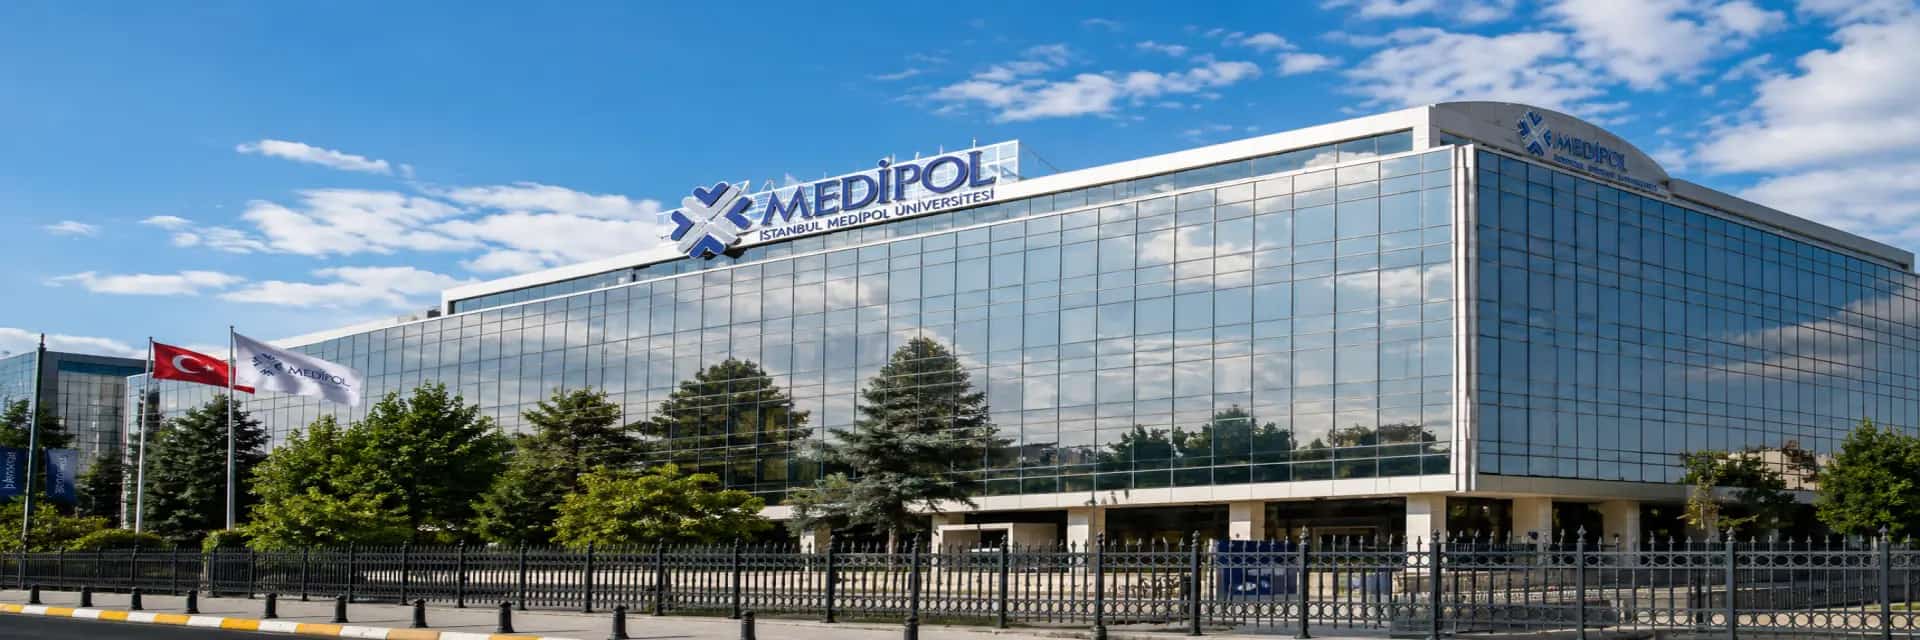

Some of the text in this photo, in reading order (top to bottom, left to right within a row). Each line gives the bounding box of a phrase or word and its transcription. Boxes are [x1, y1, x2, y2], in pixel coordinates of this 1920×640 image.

[760, 150, 997, 226] MEDİPOL
[827, 208, 890, 229] MEDİPOL
[895, 188, 995, 216] ÜNİVERSİTESİ
